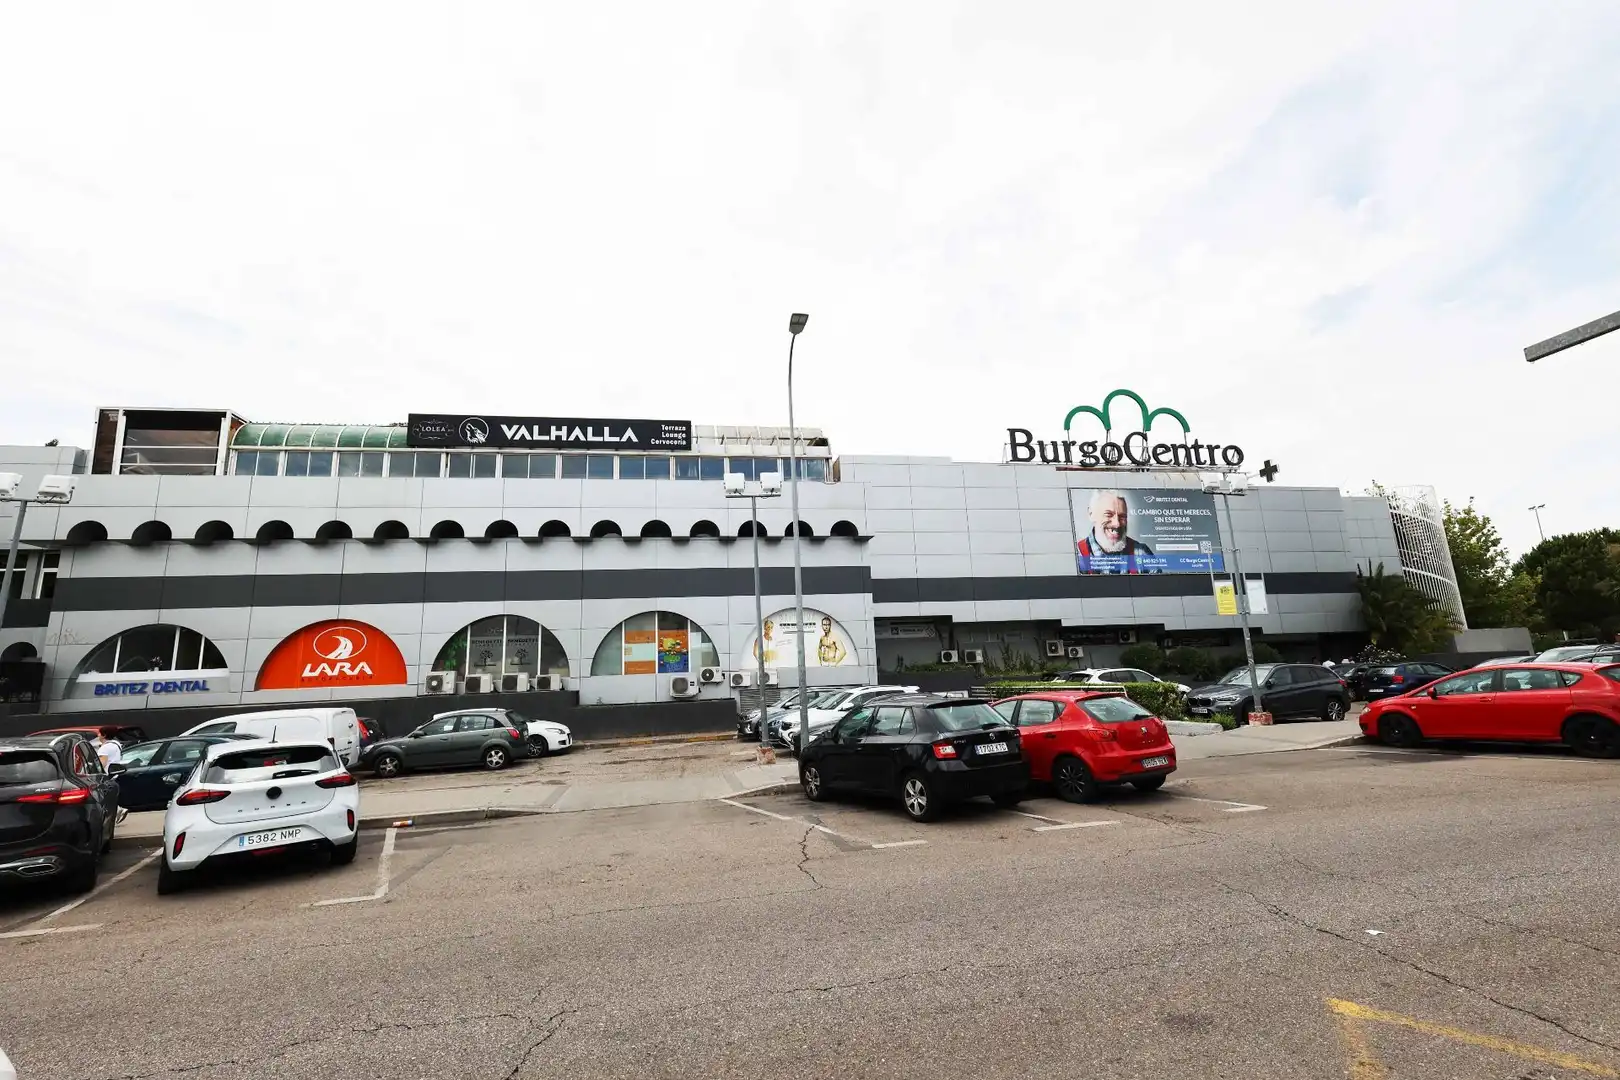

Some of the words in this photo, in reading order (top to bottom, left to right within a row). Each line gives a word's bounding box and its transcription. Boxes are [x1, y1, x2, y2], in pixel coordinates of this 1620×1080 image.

[500, 424, 639, 443] VALHALLA
[661, 431, 687, 439] Lounge
[1007, 428, 1244, 467] BurgoCentro
[301, 661, 373, 677] LARA
[94, 682, 149, 696] BRITEZ
[152, 680, 210, 693] DENTAL
[248, 832, 277, 845] 5382
[280, 829, 301, 840] NMP
